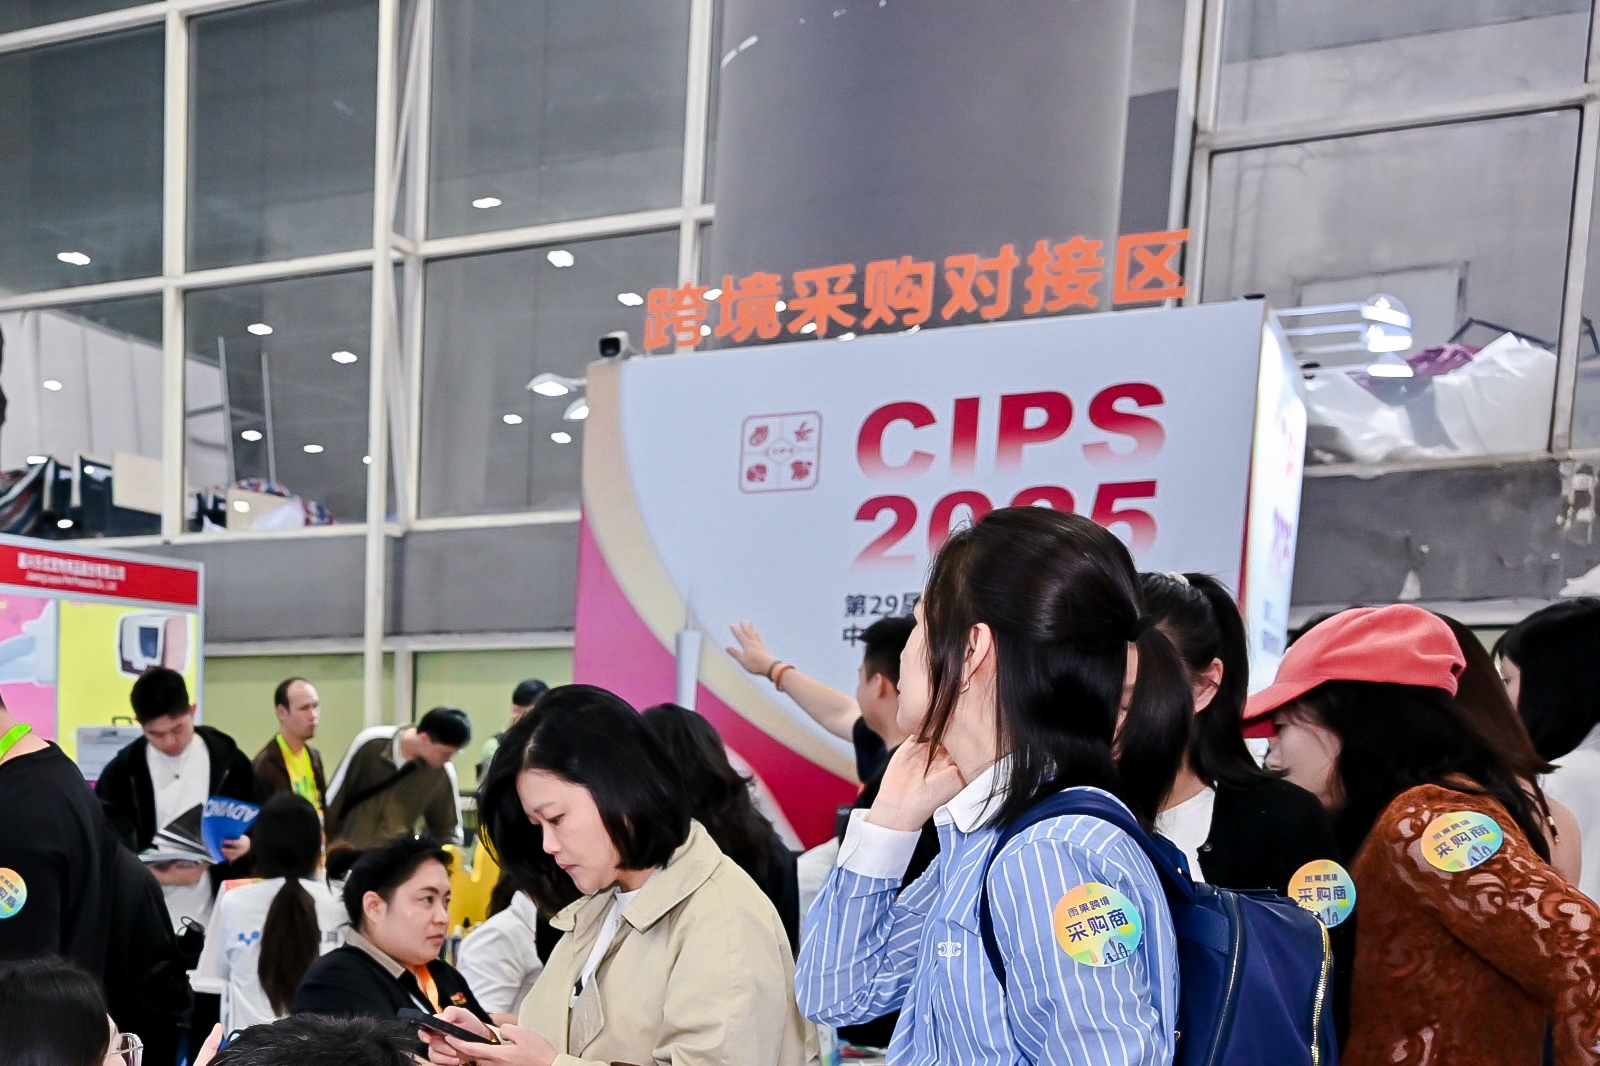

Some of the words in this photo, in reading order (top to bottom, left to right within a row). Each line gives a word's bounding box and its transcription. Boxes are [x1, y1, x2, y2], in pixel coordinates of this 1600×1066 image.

[644, 229, 1190, 350] 跨境采购对接区
[856, 381, 1167, 480] CIPS
[1434, 823, 1491, 859] 采购商
[1067, 896, 1111, 918] 雨果跨境
[1298, 886, 1346, 903] 采购商
[1065, 908, 1129, 943] 采购商
